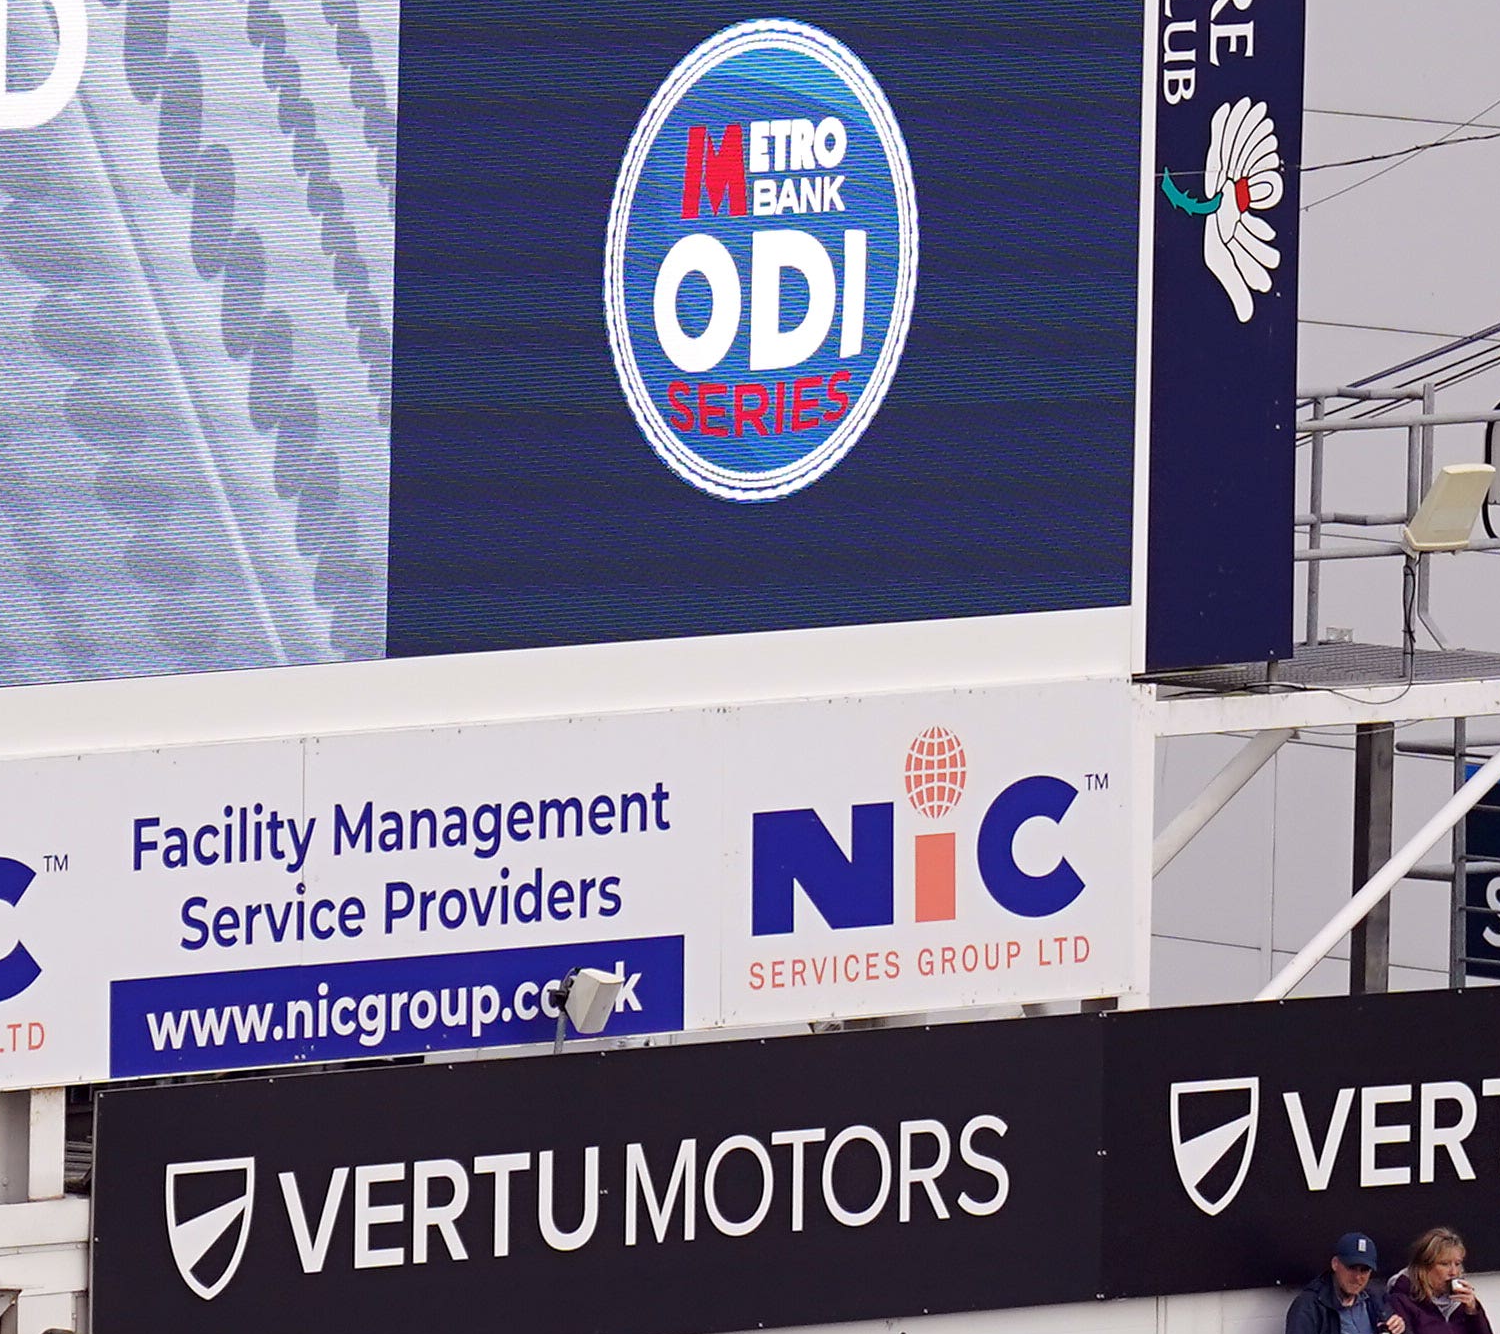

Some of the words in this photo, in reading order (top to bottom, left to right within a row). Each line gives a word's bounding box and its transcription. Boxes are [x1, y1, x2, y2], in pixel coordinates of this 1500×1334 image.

[681, 116, 848, 219] METRO
[752, 175, 848, 217] BANK
[653, 229, 867, 373] ODI
[666, 367, 855, 439] SERIES
[134, 803, 316, 873] Facility
[334, 783, 670, 858] Management
[181, 892, 365, 950] Service
[384, 867, 622, 932] Providers
[147, 961, 643, 1051] www.nicgroup.cok
[749, 951, 900, 990] SERVICES
[918, 941, 1020, 976] GROUP
[1039, 936, 1089, 966] LTD
[279, 1147, 599, 1273] VERTU
[626, 1115, 1009, 1245] MOTORS
